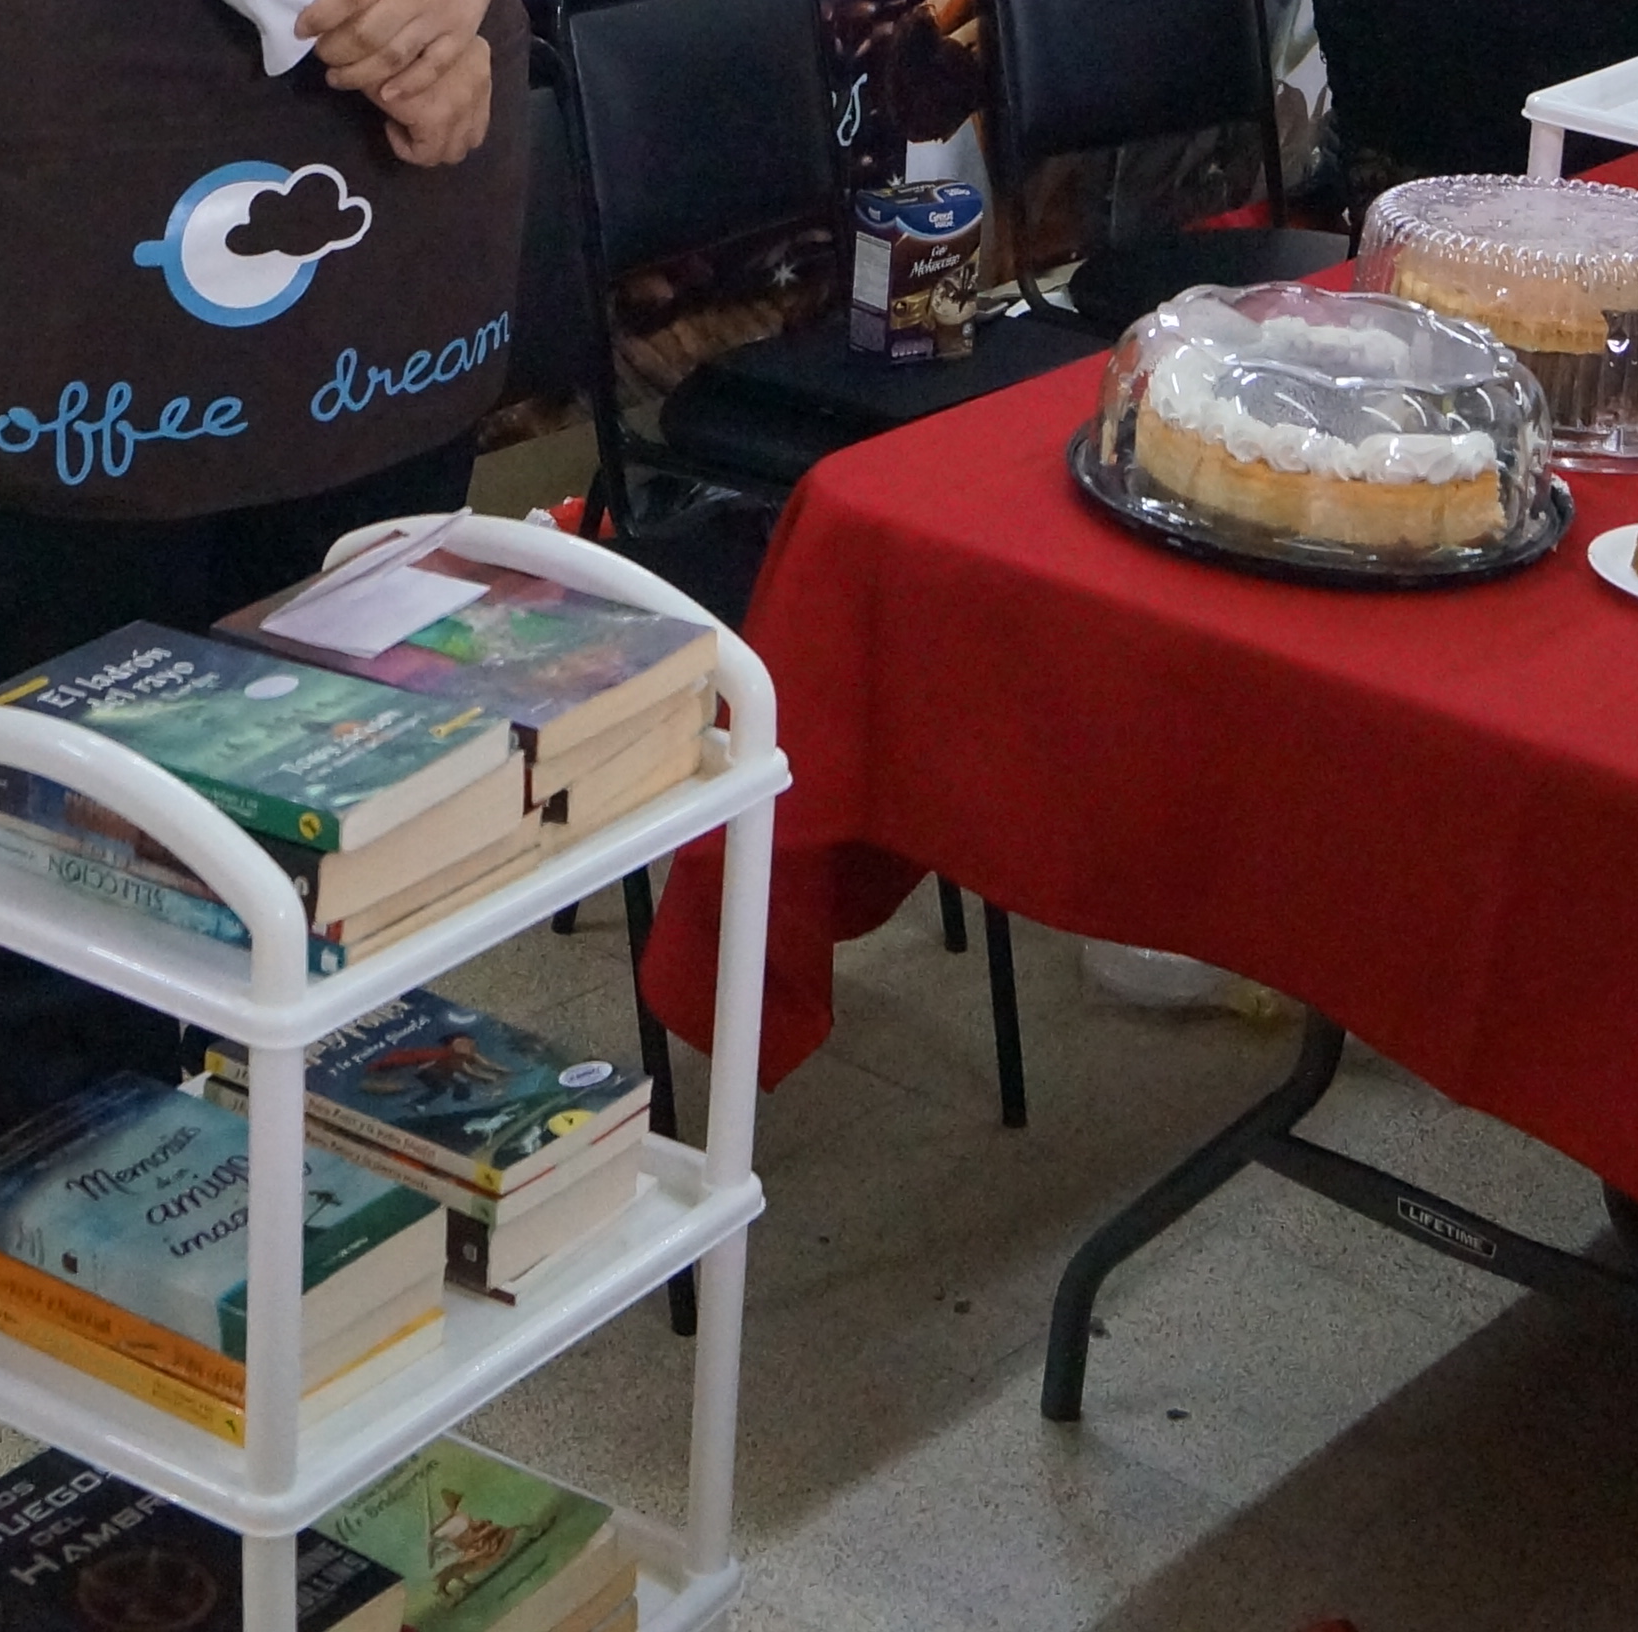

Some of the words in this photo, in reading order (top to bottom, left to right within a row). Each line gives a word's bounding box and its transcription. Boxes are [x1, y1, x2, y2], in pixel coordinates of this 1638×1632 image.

[310, 310, 512, 423] dream
[36, 683, 88, 709] El
[64, 1124, 202, 1202] Memorias
[1408, 1205, 1483, 1251] LIFETIME
[10, 1493, 165, 1587] HAMBR
